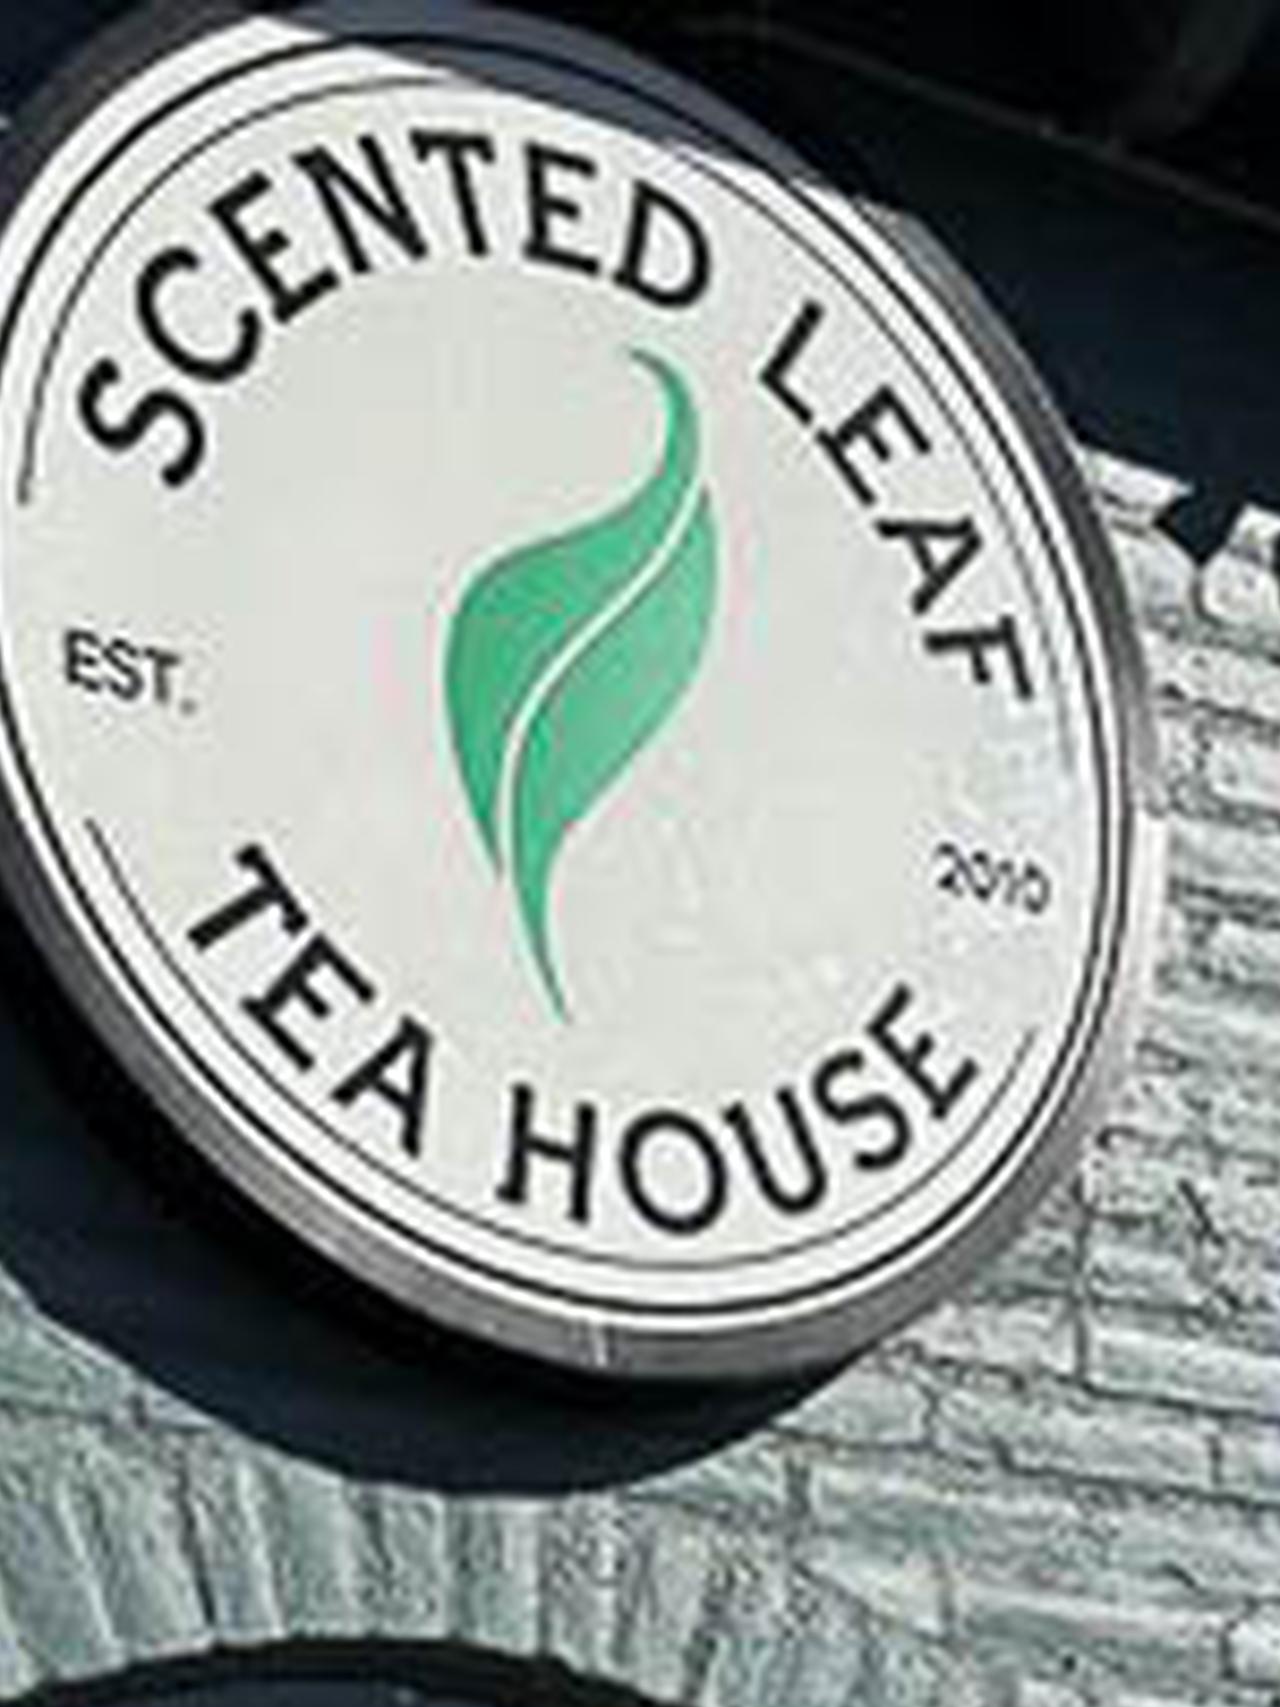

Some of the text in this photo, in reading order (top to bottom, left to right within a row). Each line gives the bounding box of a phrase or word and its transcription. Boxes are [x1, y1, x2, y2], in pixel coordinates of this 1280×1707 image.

[77, 127, 1032, 710] SCENTED LEAF
[64, 630, 196, 716] EST.
[935, 843, 1051, 917] 2010
[185, 843, 977, 1236] TEA HOUSE
